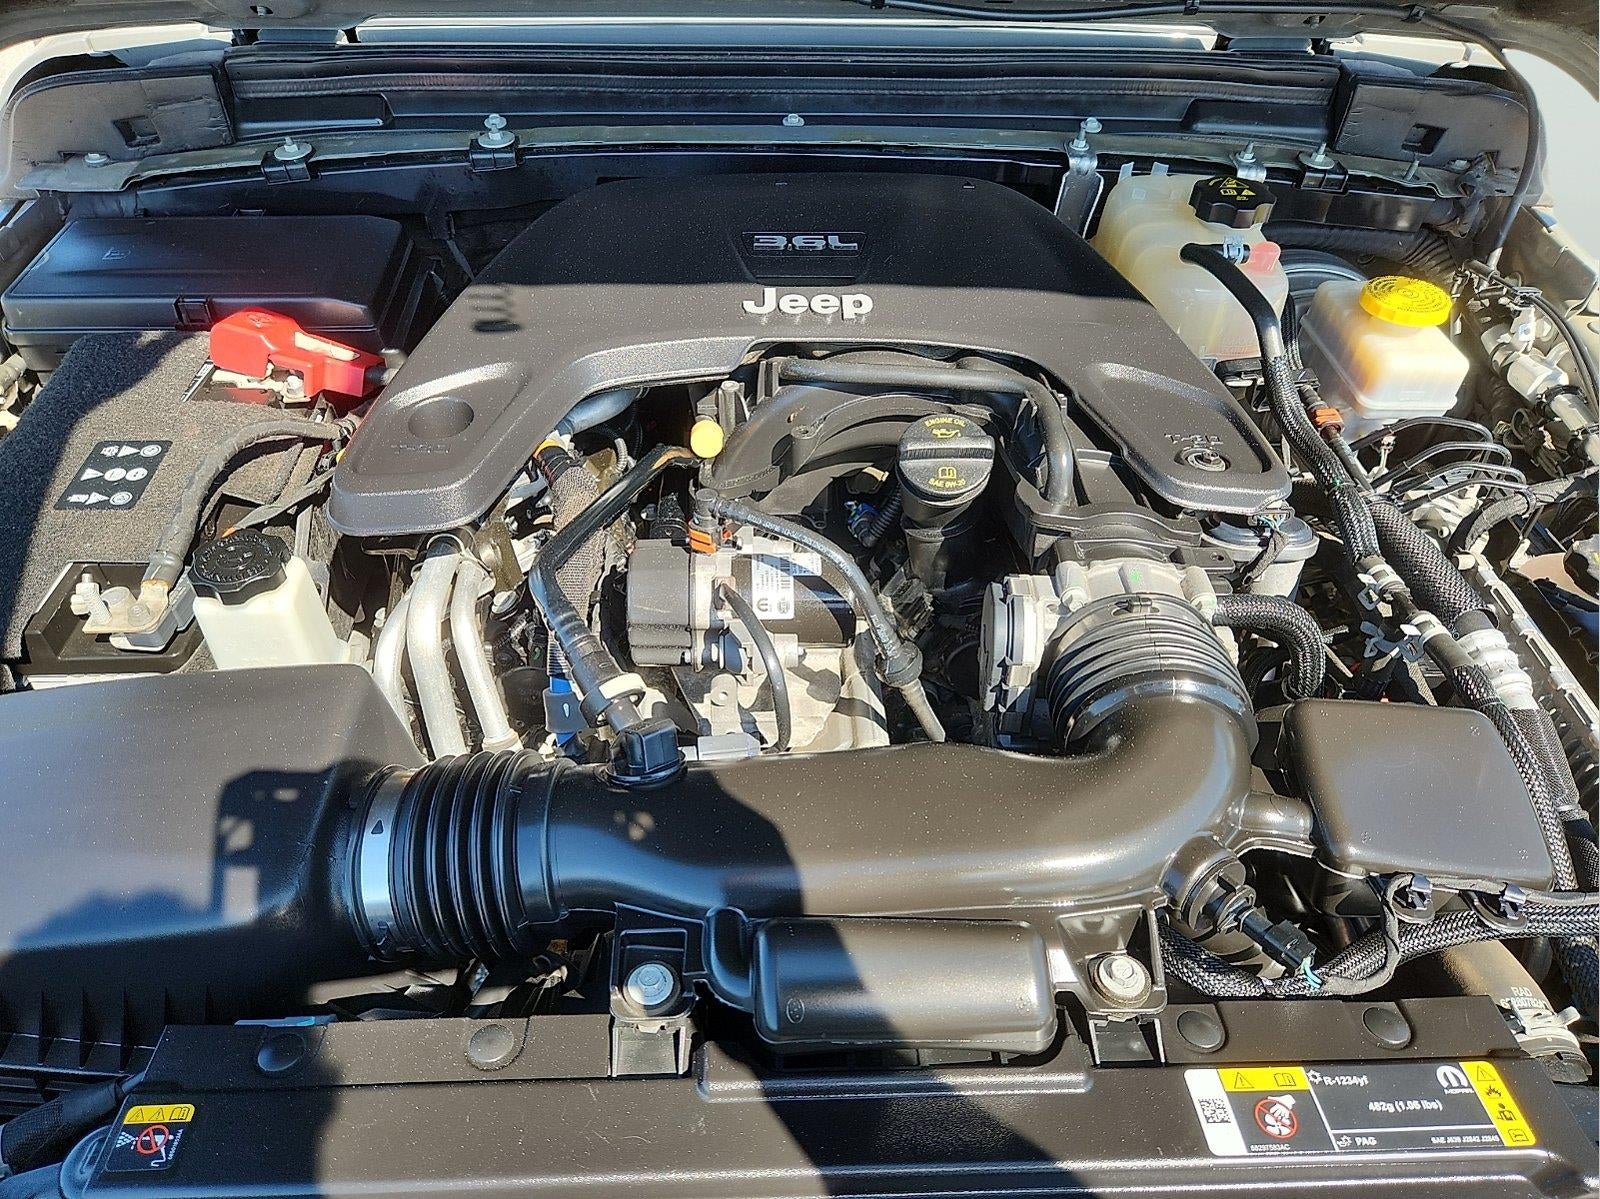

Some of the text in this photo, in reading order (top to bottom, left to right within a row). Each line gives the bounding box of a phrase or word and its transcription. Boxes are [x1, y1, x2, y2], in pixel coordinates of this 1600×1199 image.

[753, 235, 858, 251] 3.6L
[742, 287, 874, 321] Jeep
[925, 418, 966, 427] ENGINE OIL
[928, 478, 944, 487] SAE
[1510, 986, 1533, 997] RAD
[1322, 1074, 1369, 1087] R-1234yf
[1354, 1136, 1378, 1146] PAG
